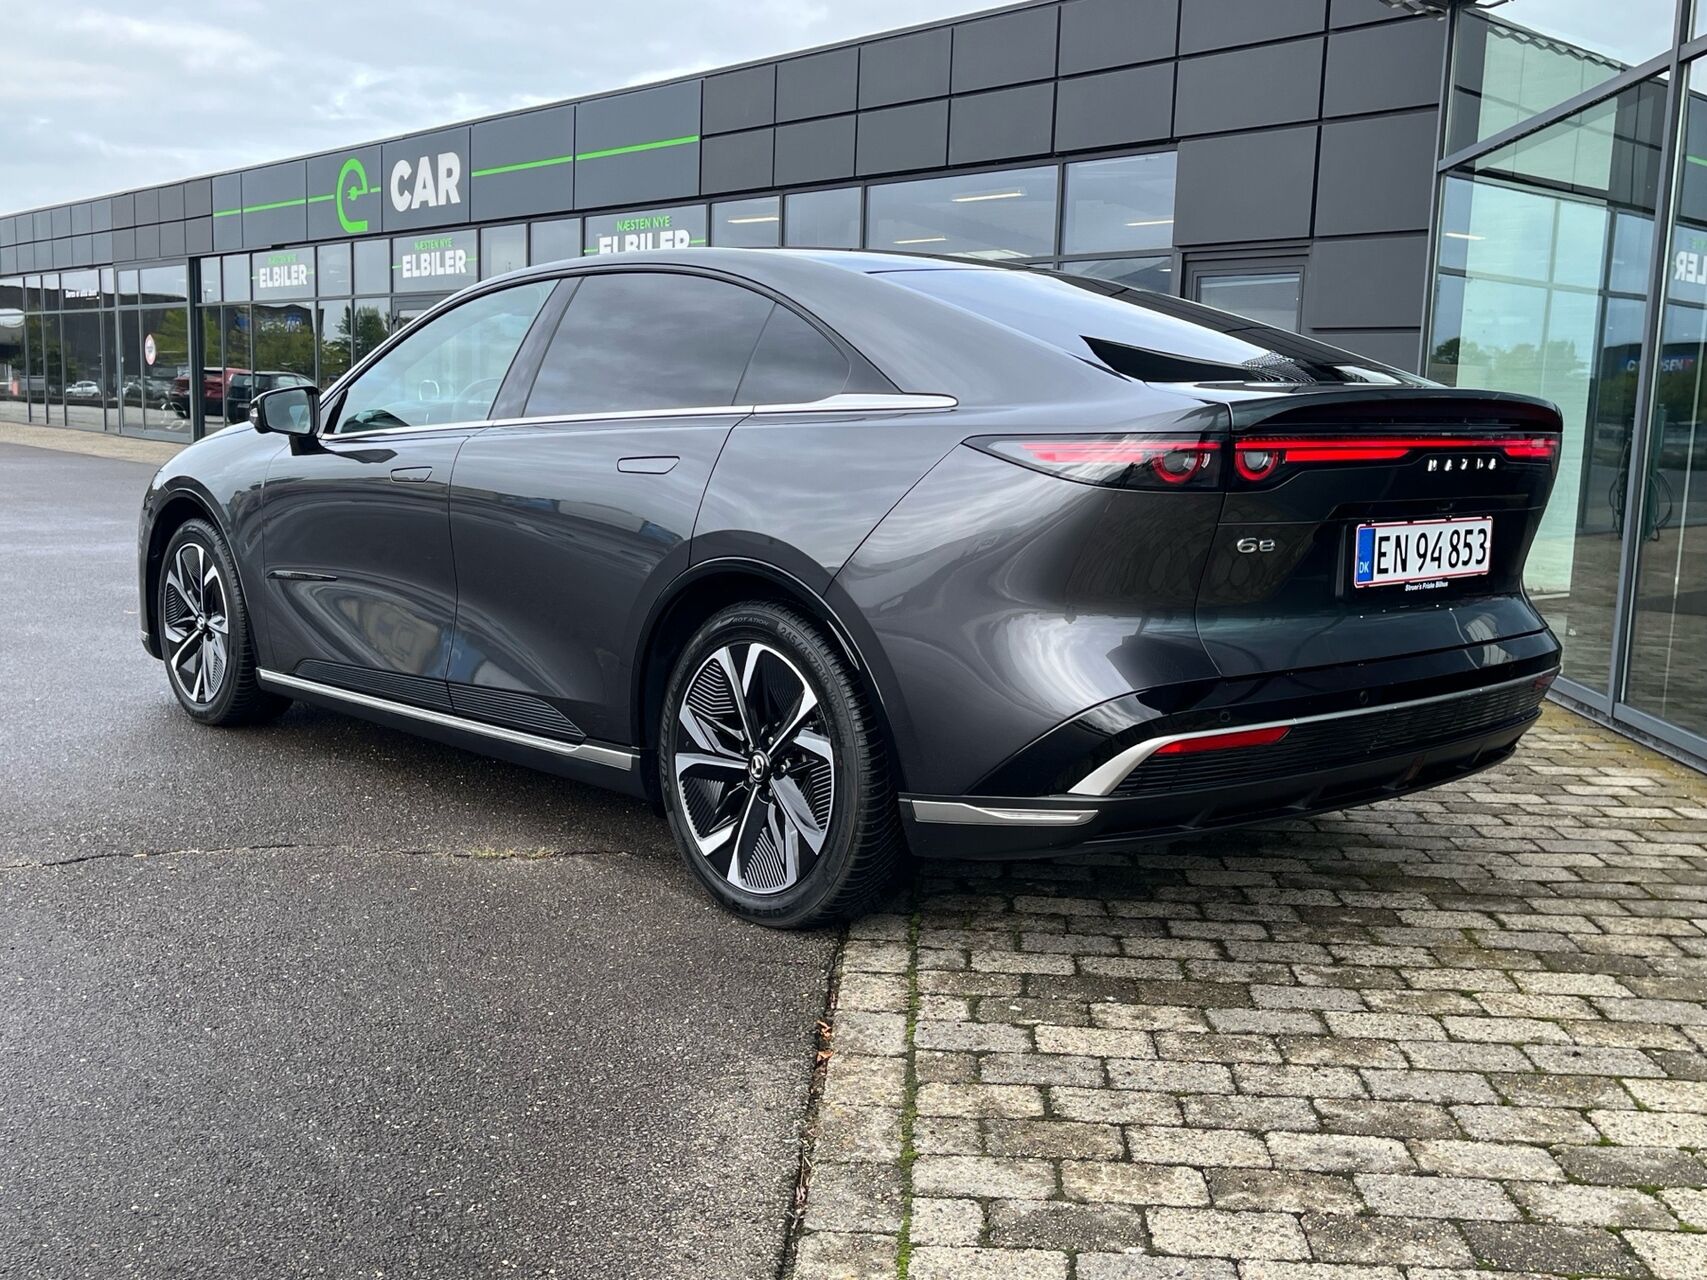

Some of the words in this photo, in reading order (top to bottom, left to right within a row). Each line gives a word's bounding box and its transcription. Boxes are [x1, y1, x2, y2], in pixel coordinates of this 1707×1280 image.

[390, 151, 461, 212] CAR
[616, 218, 651, 232] NÆSTEN
[652, 215, 670, 229] NYE
[402, 249, 467, 278] ELBILER
[259, 264, 308, 288] ELBILER
[1427, 458, 1497, 472] MAZDA
[1376, 534, 1409, 575] EN
[1359, 561, 1370, 574] DK
